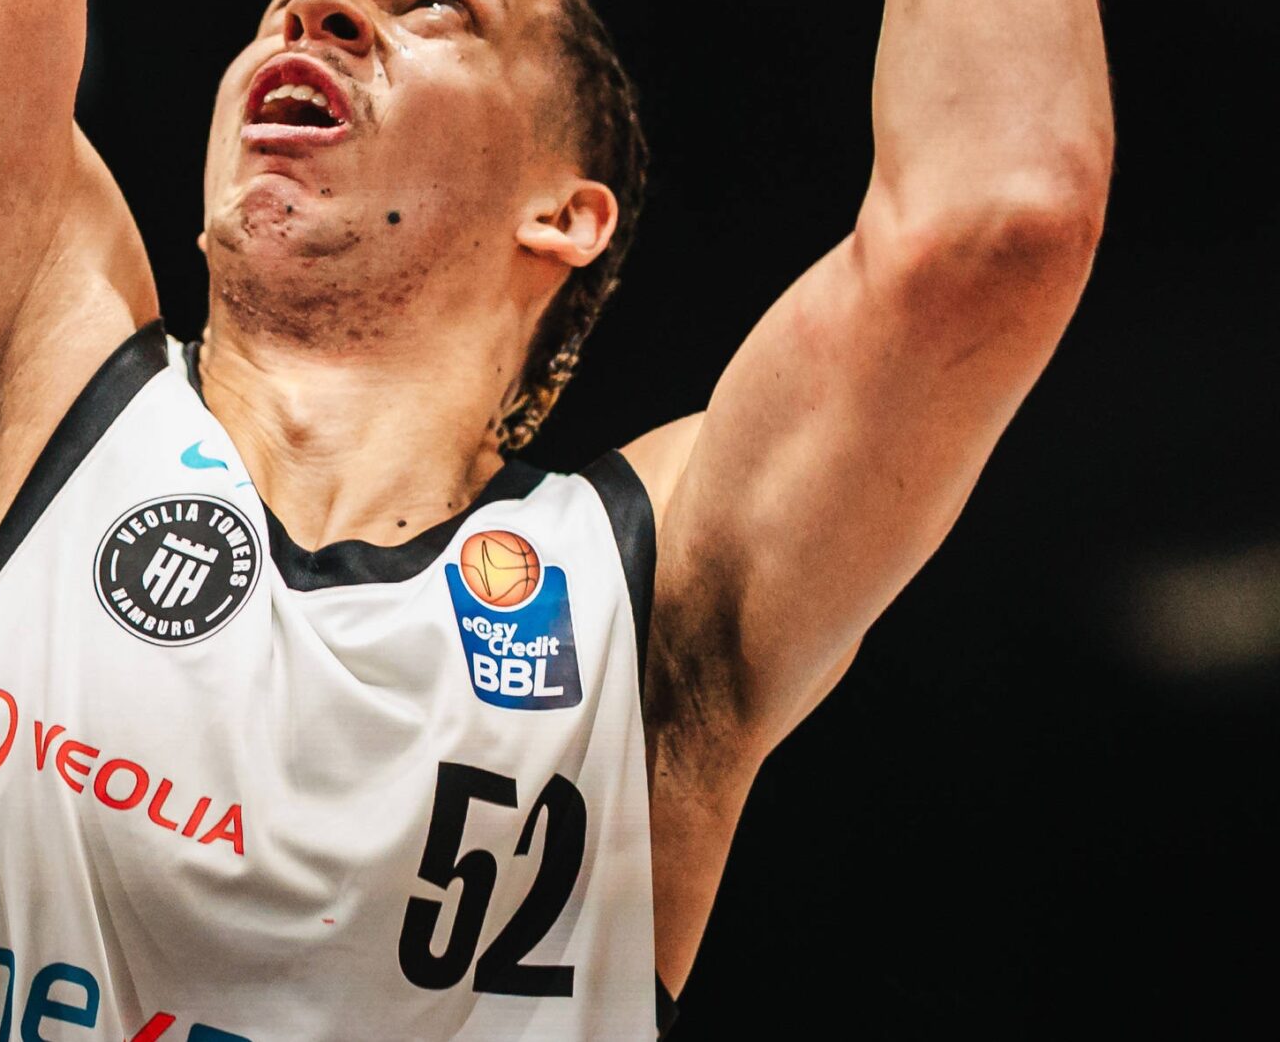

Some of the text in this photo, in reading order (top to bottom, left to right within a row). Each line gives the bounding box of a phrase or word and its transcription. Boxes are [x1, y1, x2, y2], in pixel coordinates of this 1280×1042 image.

[116, 503, 252, 588] VEOLIA TOWERS
[111, 587, 196, 636] HAMBURG
[472, 652, 564, 697] BBL
[35, 720, 244, 855] VEOLIA
[399, 762, 587, 998] 52
